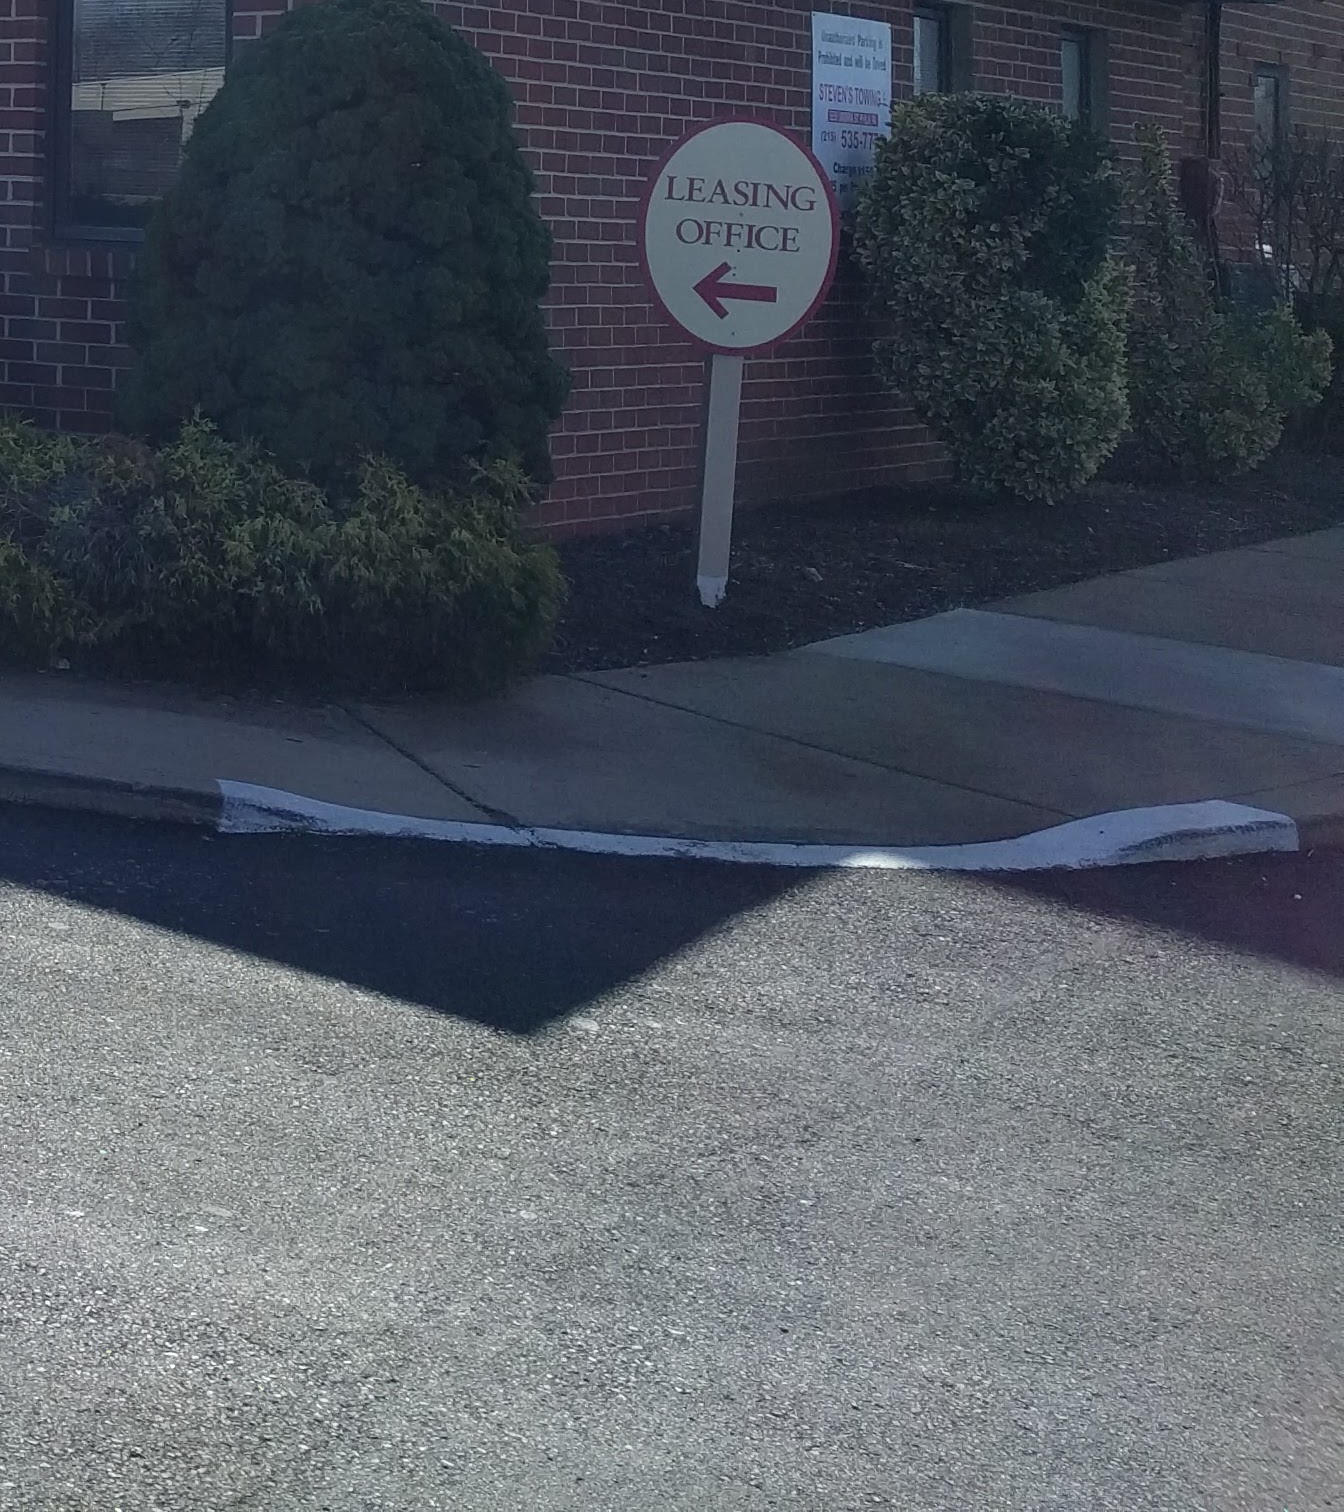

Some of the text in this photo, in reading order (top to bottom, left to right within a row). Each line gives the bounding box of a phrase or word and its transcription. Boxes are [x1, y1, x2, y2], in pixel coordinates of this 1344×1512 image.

[818, 83, 881, 107] STEVEN'S TOWING
[841, 129, 884, 150] 535-77
[664, 174, 817, 212] LEASING
[675, 217, 800, 253] OFFICE
